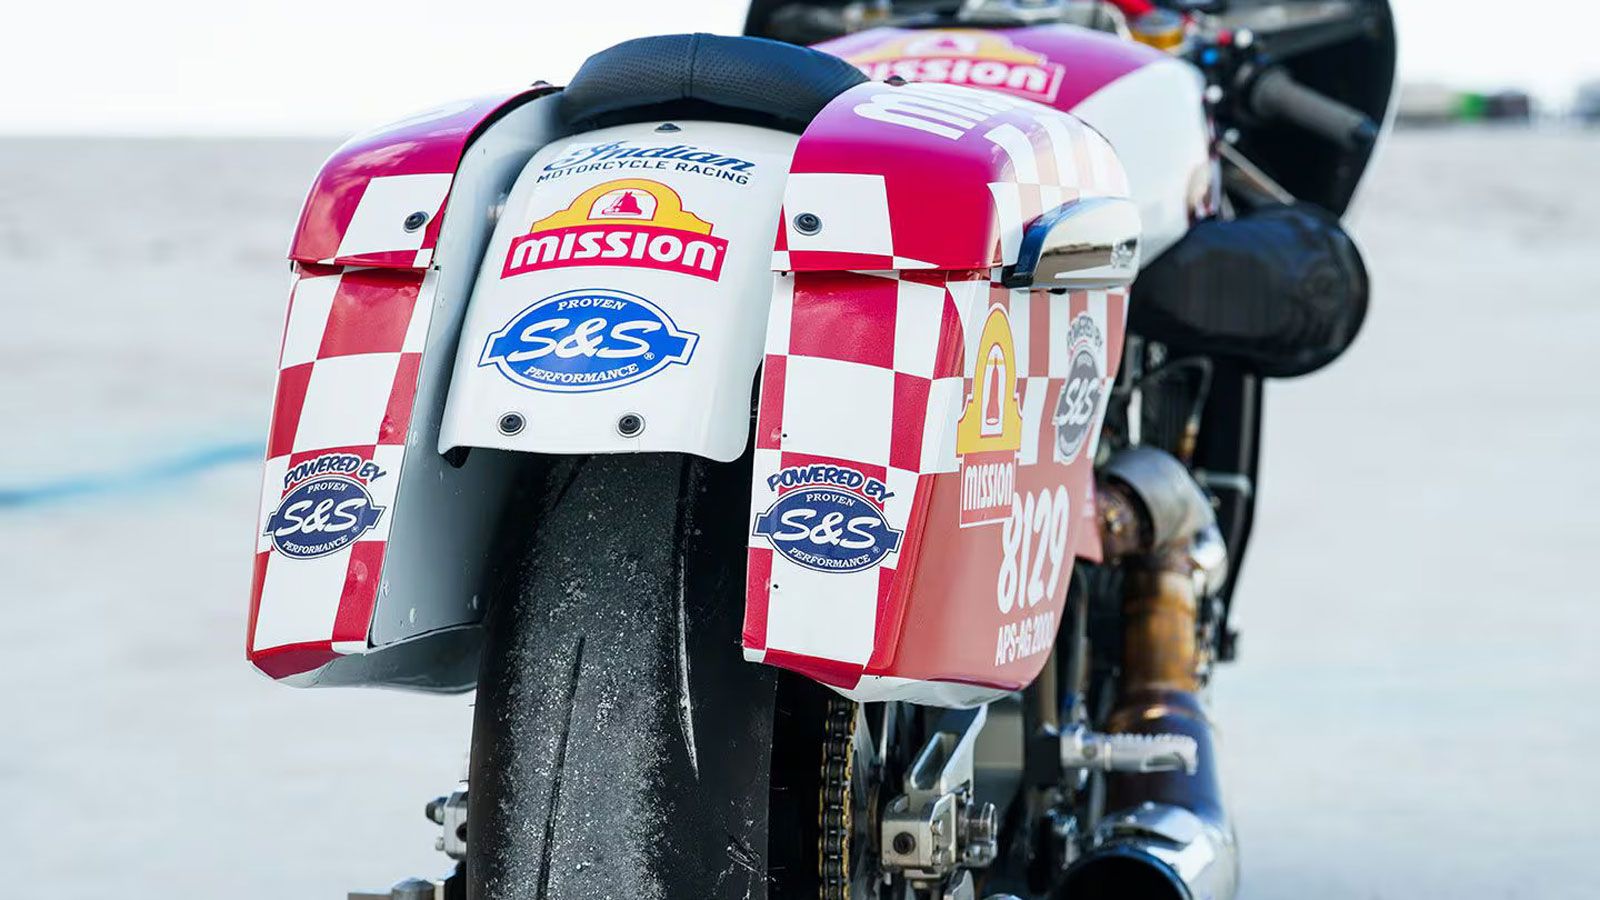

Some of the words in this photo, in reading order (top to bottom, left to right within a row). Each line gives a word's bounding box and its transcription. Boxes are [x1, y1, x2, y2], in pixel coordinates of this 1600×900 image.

[543, 141, 755, 172] Indian
[536, 160, 667, 183] MOTORCYCLE
[675, 161, 749, 186] RACING
[557, 298, 627, 311] PROVEN
[506, 317, 662, 362] S&S
[524, 364, 640, 383] PERFORMANCE
[283, 455, 360, 488] POWERED
[359, 462, 387, 482] BY
[767, 466, 863, 491] POWERED
[864, 479, 895, 502] BY
[307, 482, 348, 493] PROVEN
[806, 493, 856, 507] PROVEN
[275, 498, 367, 537] S&S
[772, 508, 882, 549] S&S
[282, 534, 348, 555] PERFORMANCE
[788, 547, 871, 568] PERFORMANCE
[997, 484, 1070, 614] 8129
